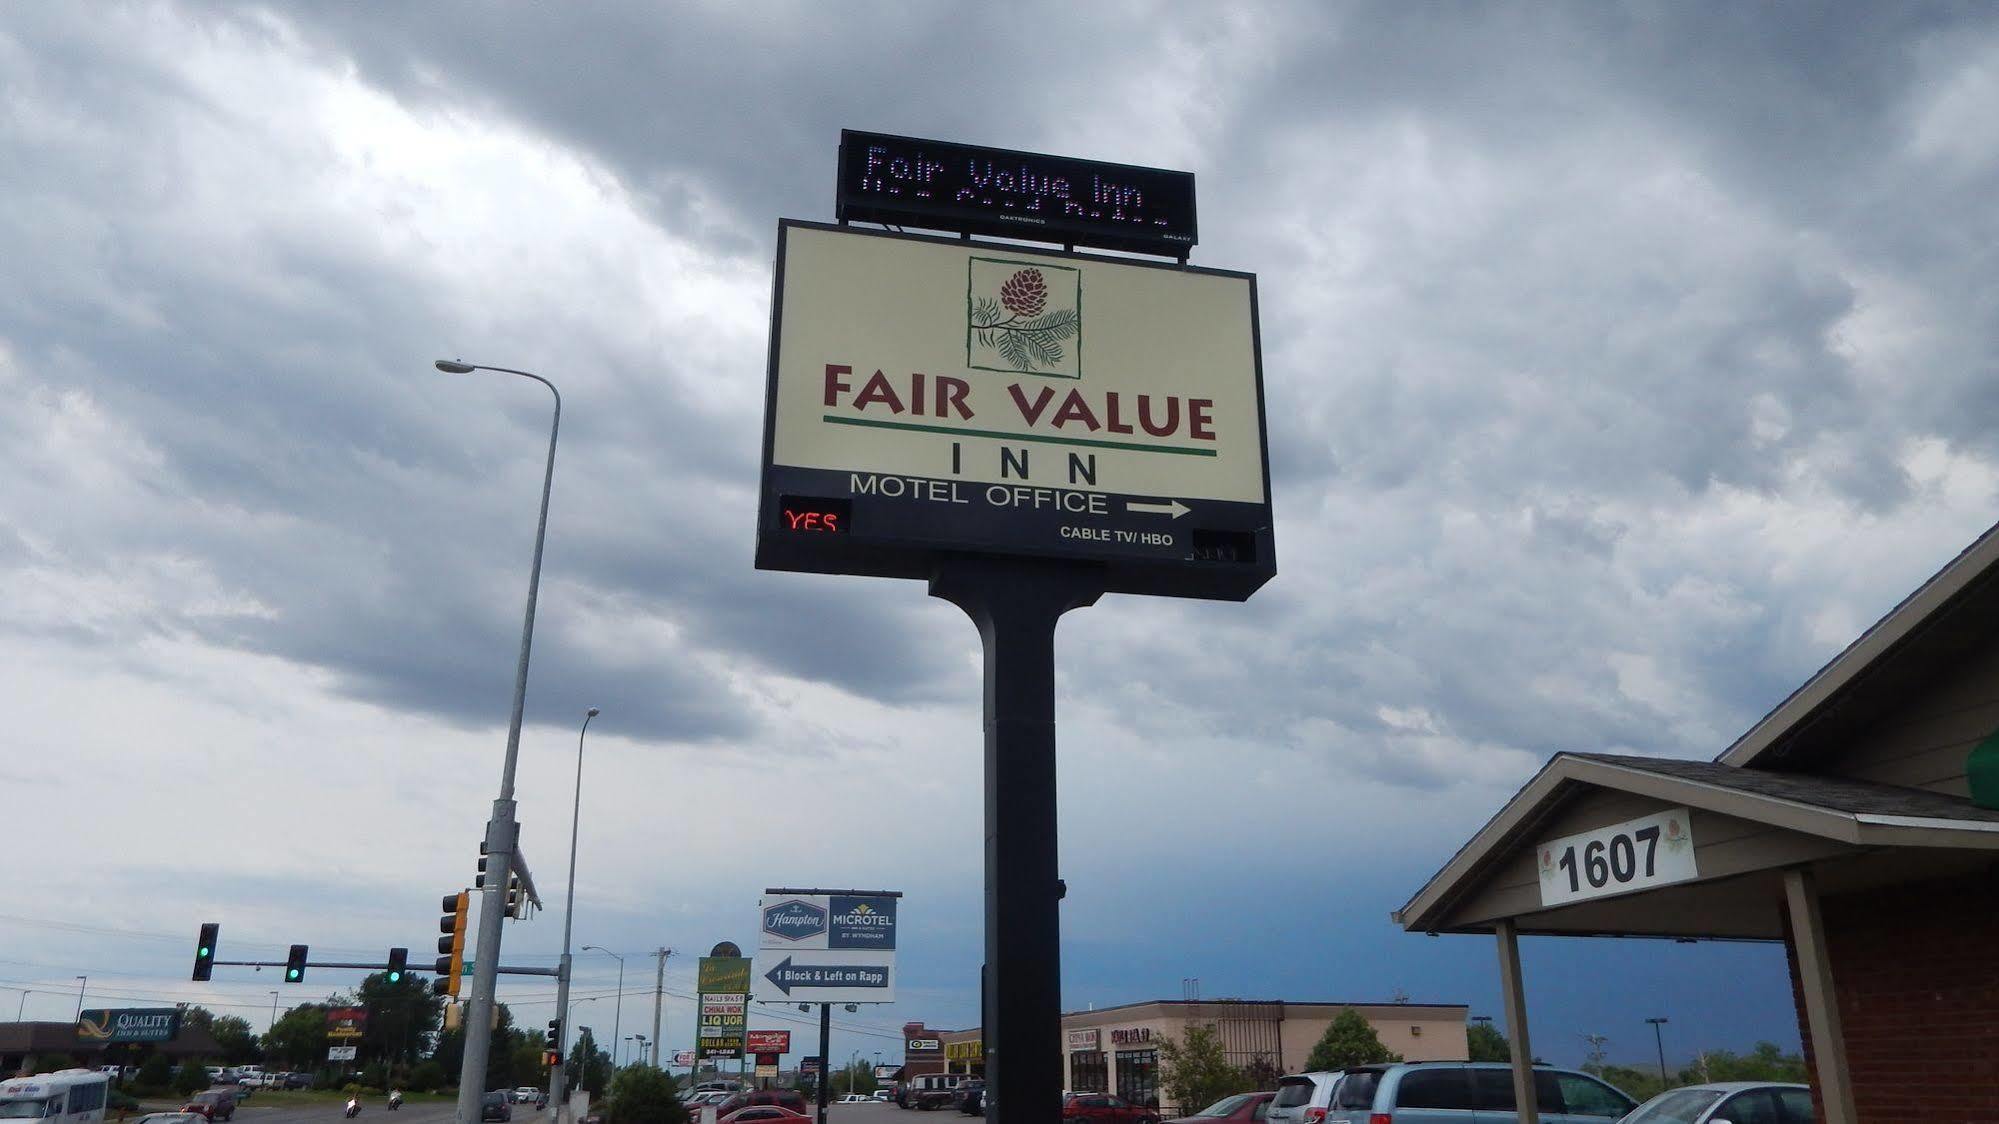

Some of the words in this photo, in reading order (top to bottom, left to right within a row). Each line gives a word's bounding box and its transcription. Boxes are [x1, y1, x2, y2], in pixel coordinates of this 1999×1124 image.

[867, 146, 944, 183] Fair
[969, 159, 1071, 198] Value
[1094, 174, 1143, 207] Inn
[824, 363, 975, 421] FAIR
[1007, 382, 1216, 441] VALUE
[952, 442, 1097, 486] INN
[850, 473, 969, 505] MOTEL
[985, 484, 1109, 515] OFFICE
[784, 508, 838, 533] YES
[1060, 525, 1111, 543] CABLE
[1140, 530, 1174, 547] HBO
[1558, 824, 1661, 893] 1607
[767, 912, 825, 929] Hampton
[833, 915, 893, 926] MICROTEL
[852, 932, 885, 941] WYNDHAM
[784, 970, 812, 981] Block
[814, 971, 821, 981] &
[824, 970, 843, 981] Left
[845, 973, 857, 981] on
[859, 971, 883, 984] Rapp
[703, 1005, 725, 1014] CHINA
[726, 1005, 743, 1014] WOK
[117, 1013, 173, 1029] QUALITY
